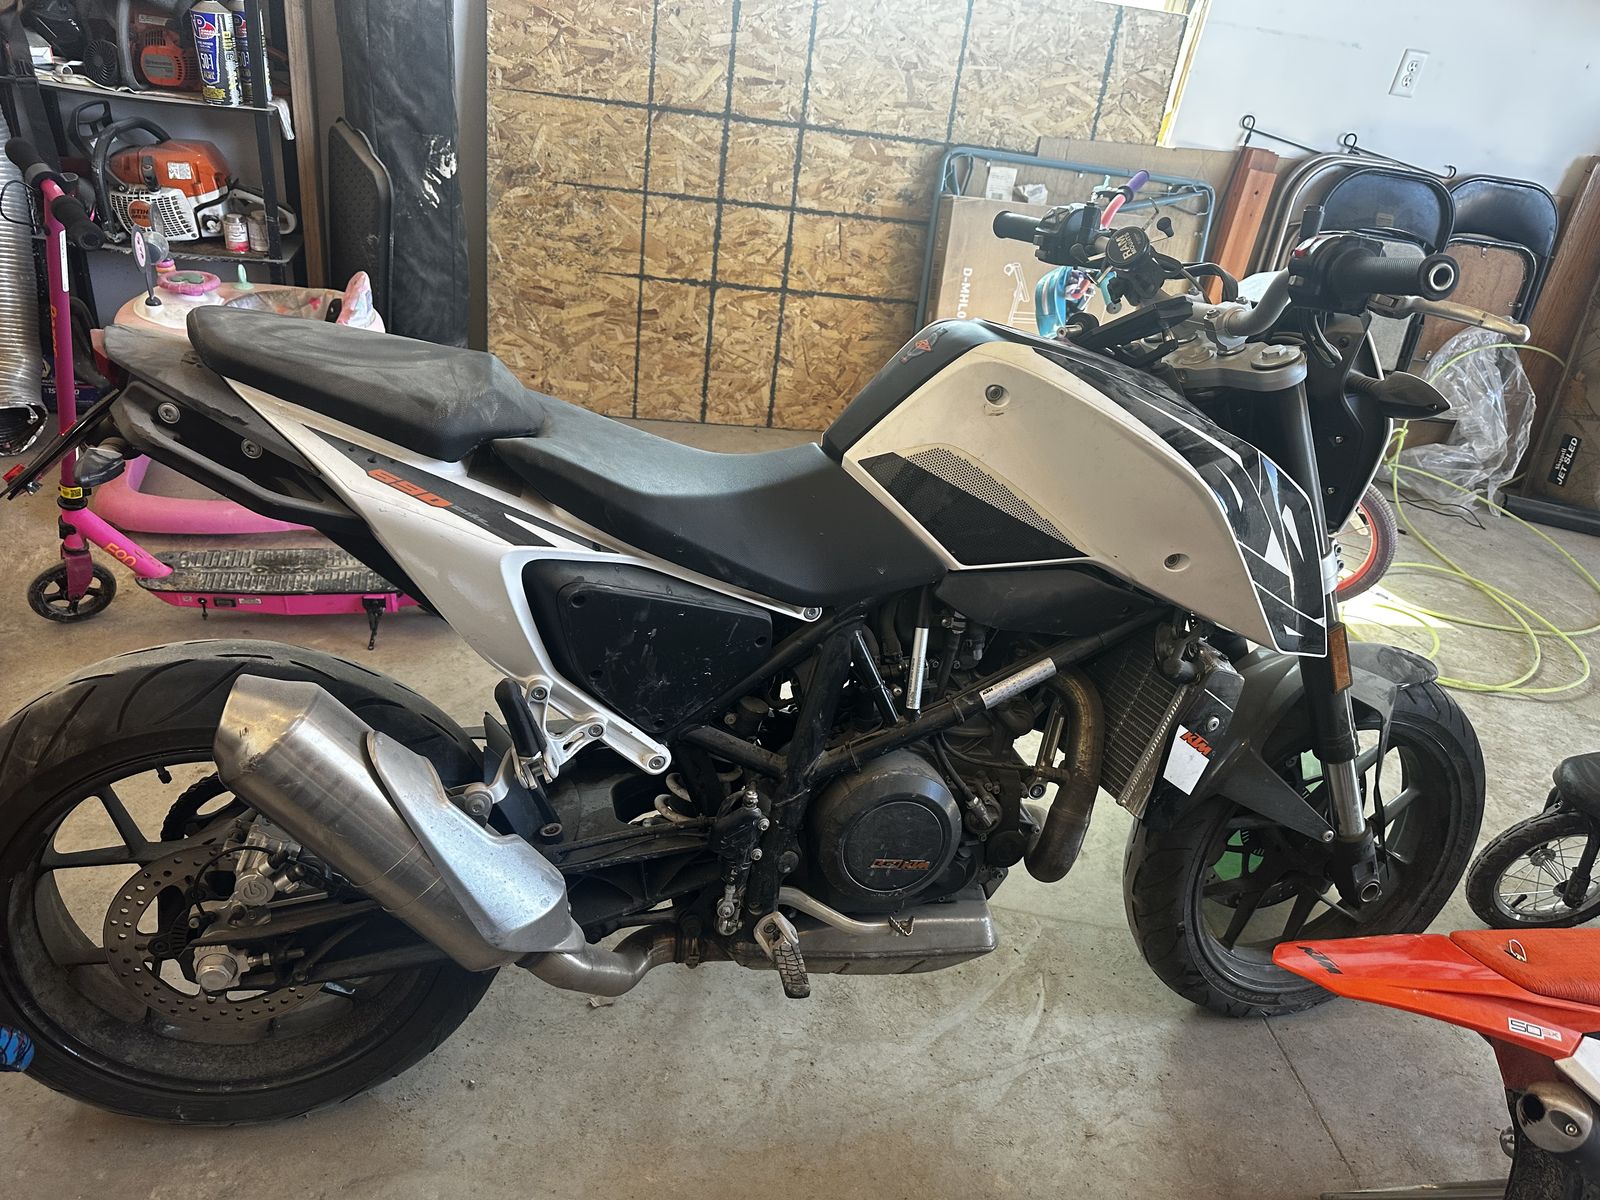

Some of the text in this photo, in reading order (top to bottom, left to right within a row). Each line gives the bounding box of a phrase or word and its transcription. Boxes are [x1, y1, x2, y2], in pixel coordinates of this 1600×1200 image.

[1115, 233, 1132, 260] RAM
[1556, 437, 1578, 485] JET SLED
[367, 468, 454, 508] 690
[1180, 731, 1212, 756] KTM
[1296, 945, 1344, 975] KTM
